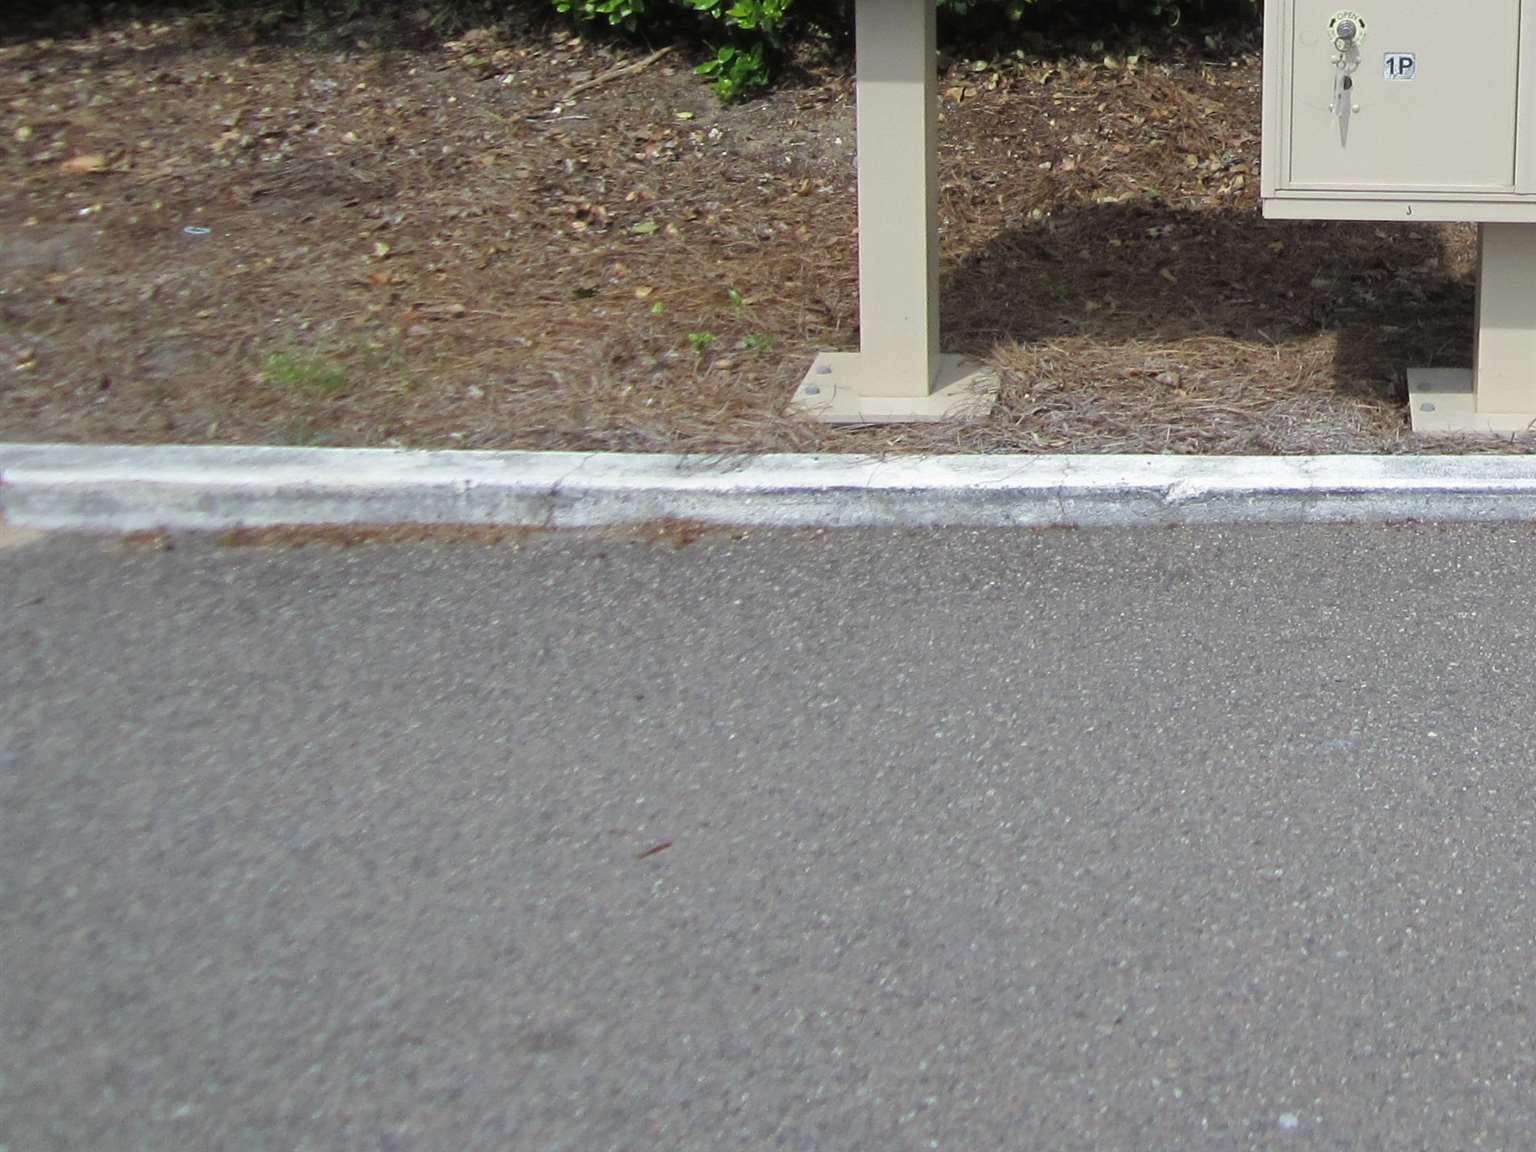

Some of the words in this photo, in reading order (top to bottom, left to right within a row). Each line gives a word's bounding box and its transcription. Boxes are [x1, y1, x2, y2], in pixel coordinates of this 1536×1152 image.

[1336, 10, 1358, 21] OPEN
[1386, 56, 1414, 75] 1P
[1405, 205, 1412, 216] J
